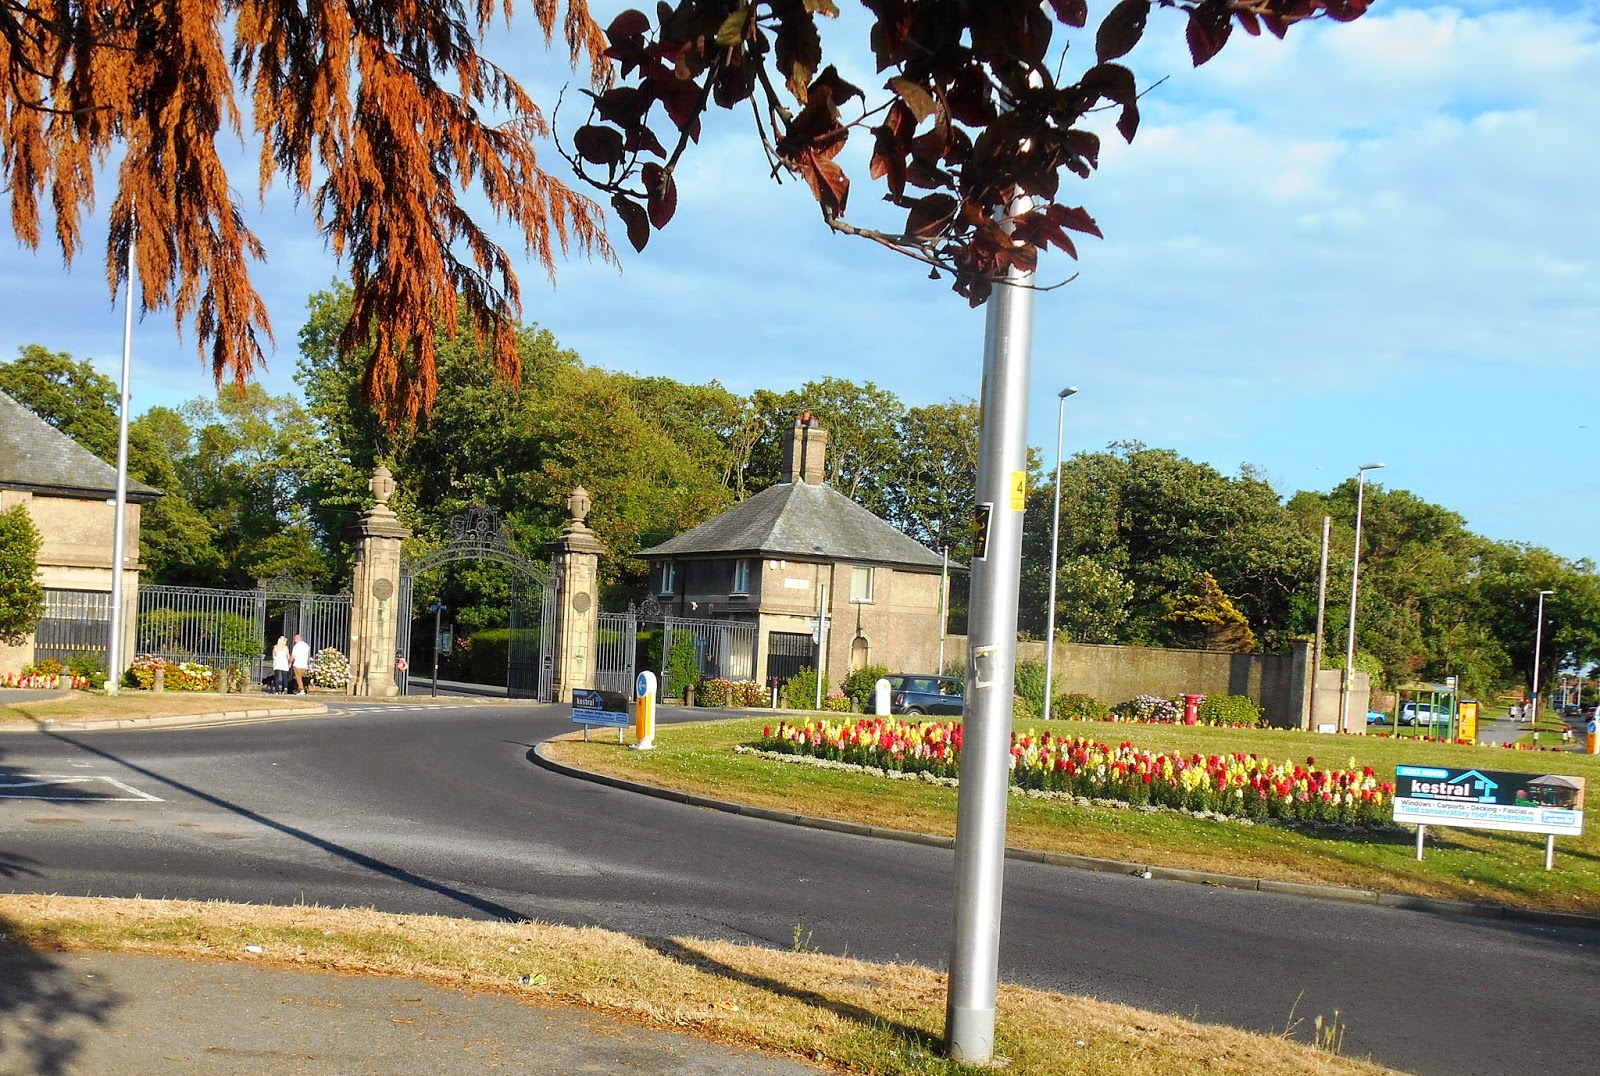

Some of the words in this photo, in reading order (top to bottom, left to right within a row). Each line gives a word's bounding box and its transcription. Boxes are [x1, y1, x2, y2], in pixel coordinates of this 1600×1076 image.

[1017, 480, 1023, 494] 4
[576, 697, 595, 706] kestral
[1411, 780, 1470, 796] kestral
[1401, 799, 1431, 808] Windows
[1437, 802, 1465, 811] Carports
[1471, 805, 1497, 814] Decking
[1503, 807, 1527, 815] Fascias
[1401, 805, 1420, 813] Tiled
[1421, 807, 1470, 818] conservatory
[1472, 811, 1488, 819] roof
[1489, 813, 1535, 822] conversions
